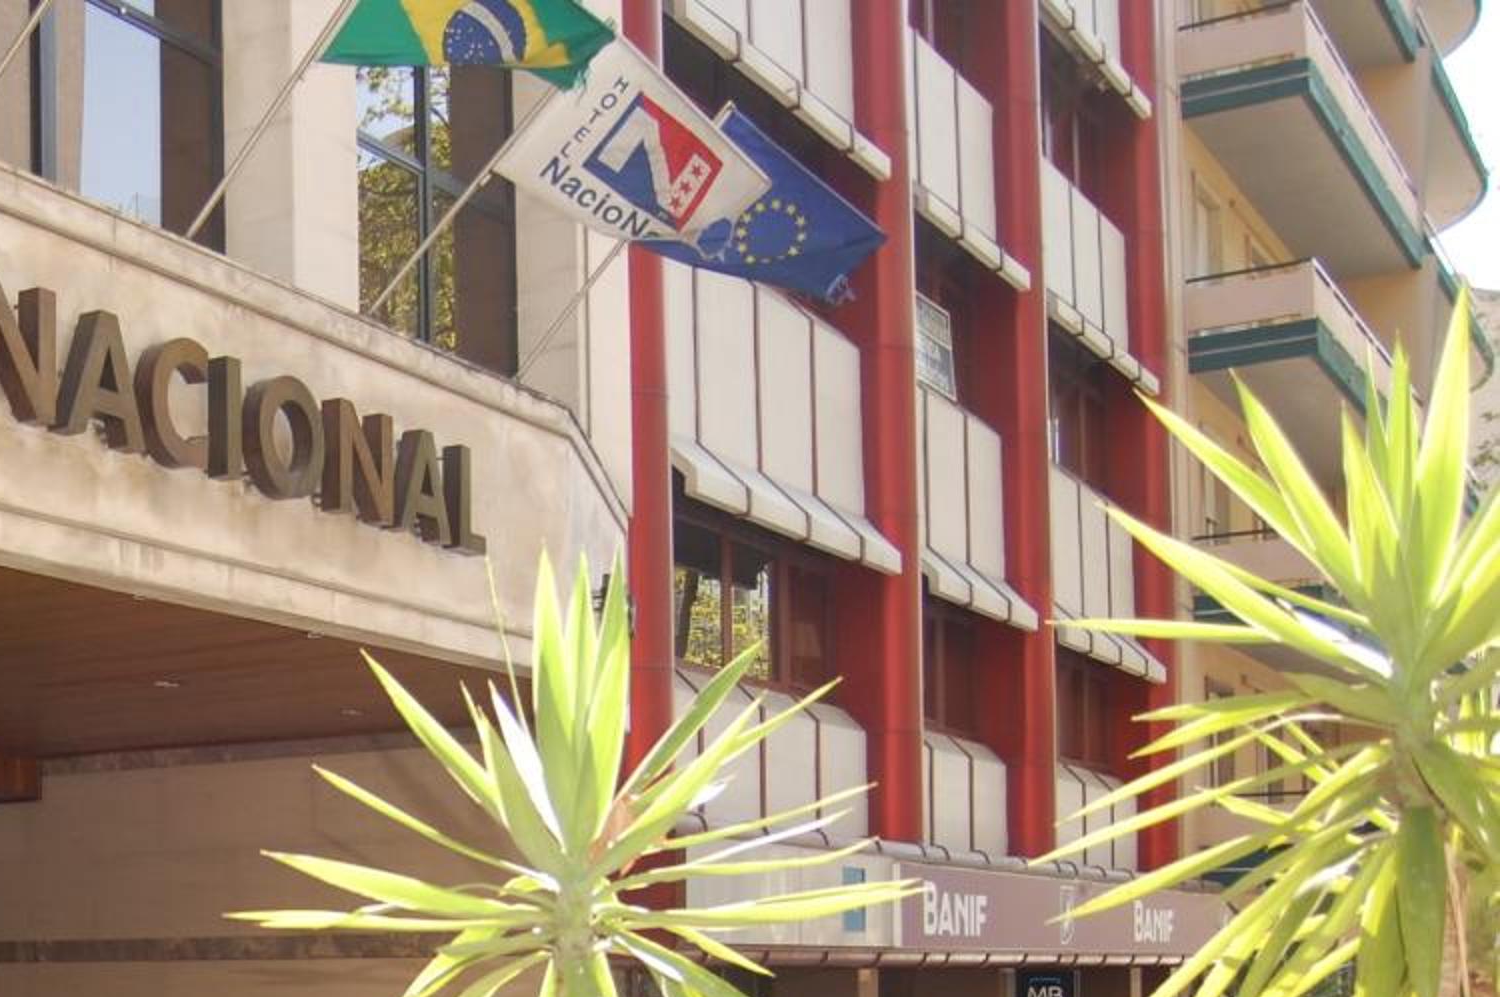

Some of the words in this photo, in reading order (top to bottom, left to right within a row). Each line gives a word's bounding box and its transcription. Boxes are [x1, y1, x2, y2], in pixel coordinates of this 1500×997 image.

[560, 76, 629, 159] HOTEL
[539, 156, 660, 238] NacioN
[923, 880, 988, 936] BANIF
[1133, 899, 1174, 943] BANIF
